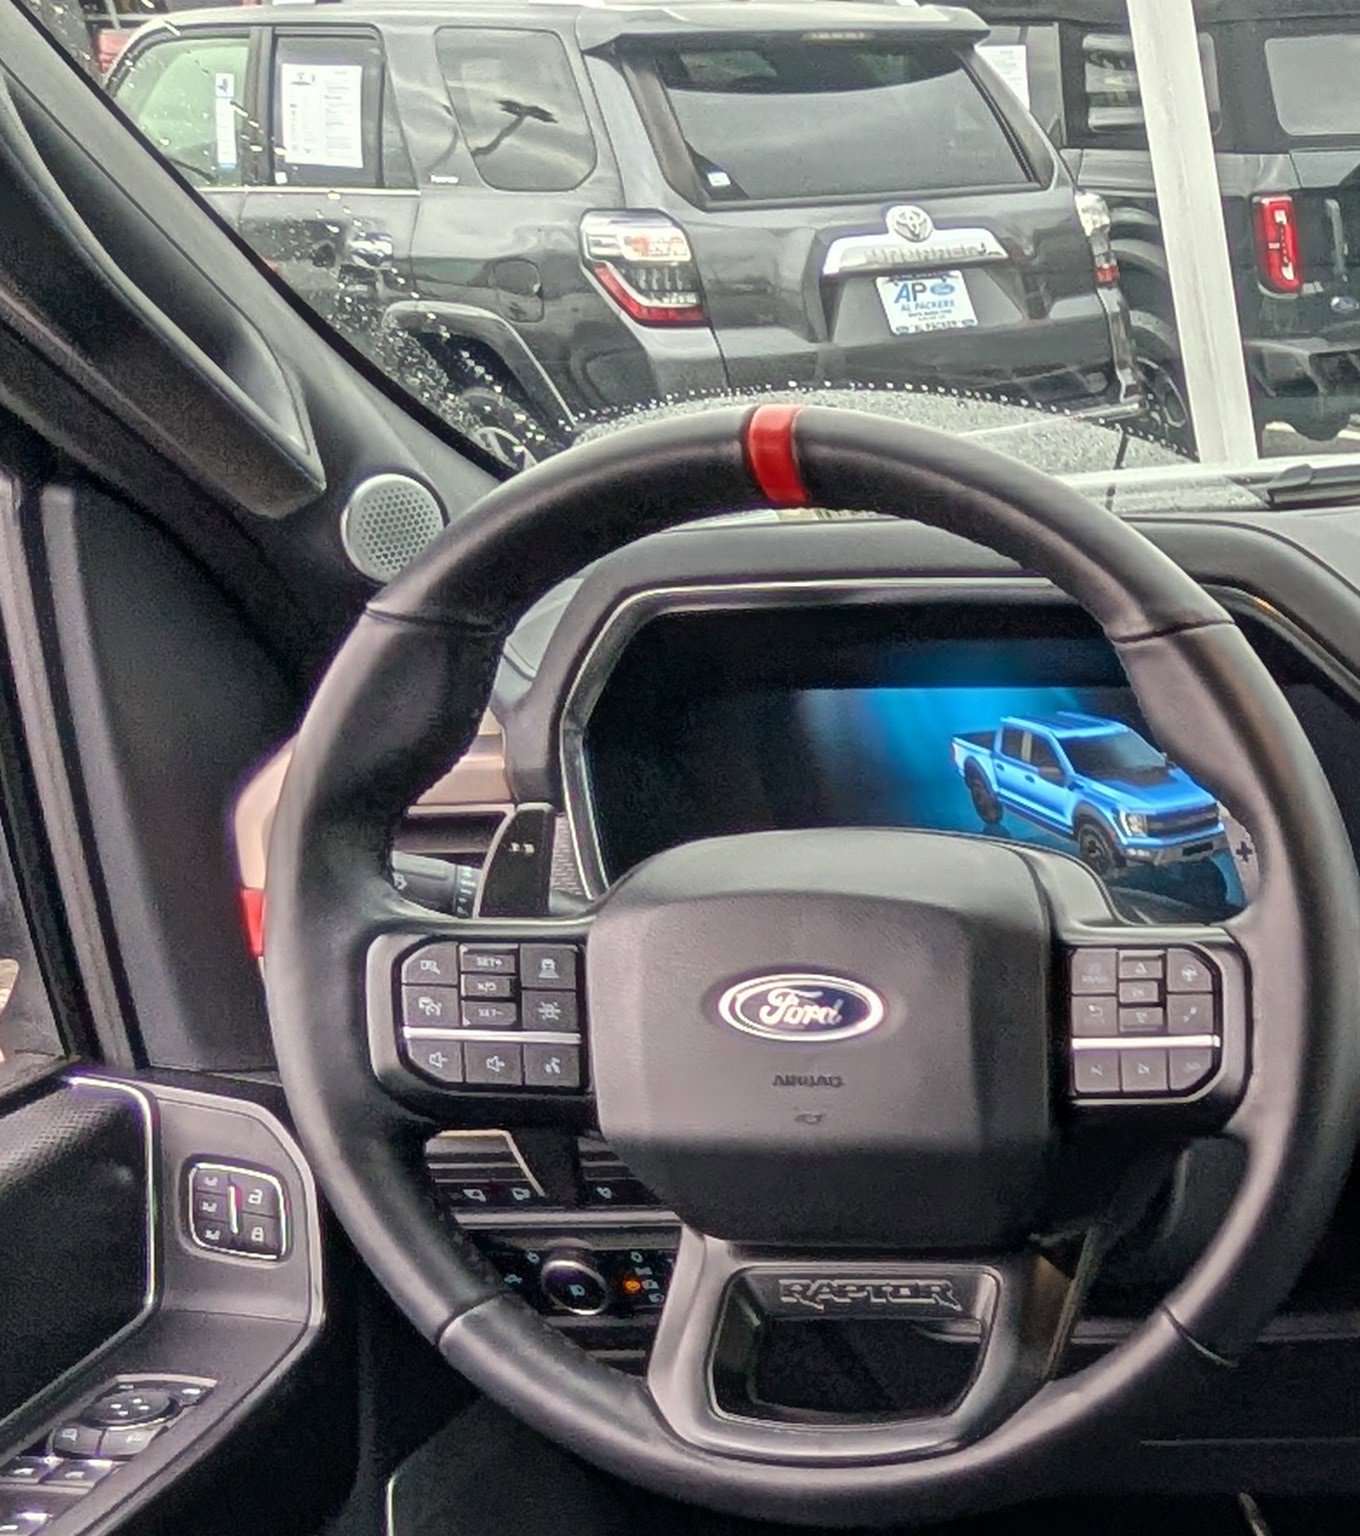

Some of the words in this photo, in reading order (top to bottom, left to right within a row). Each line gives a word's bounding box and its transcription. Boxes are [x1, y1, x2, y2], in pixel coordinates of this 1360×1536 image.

[894, 282, 927, 304] AP
[759, 988, 844, 1025] Ford
[778, 1278, 963, 1312] RAPTOR
